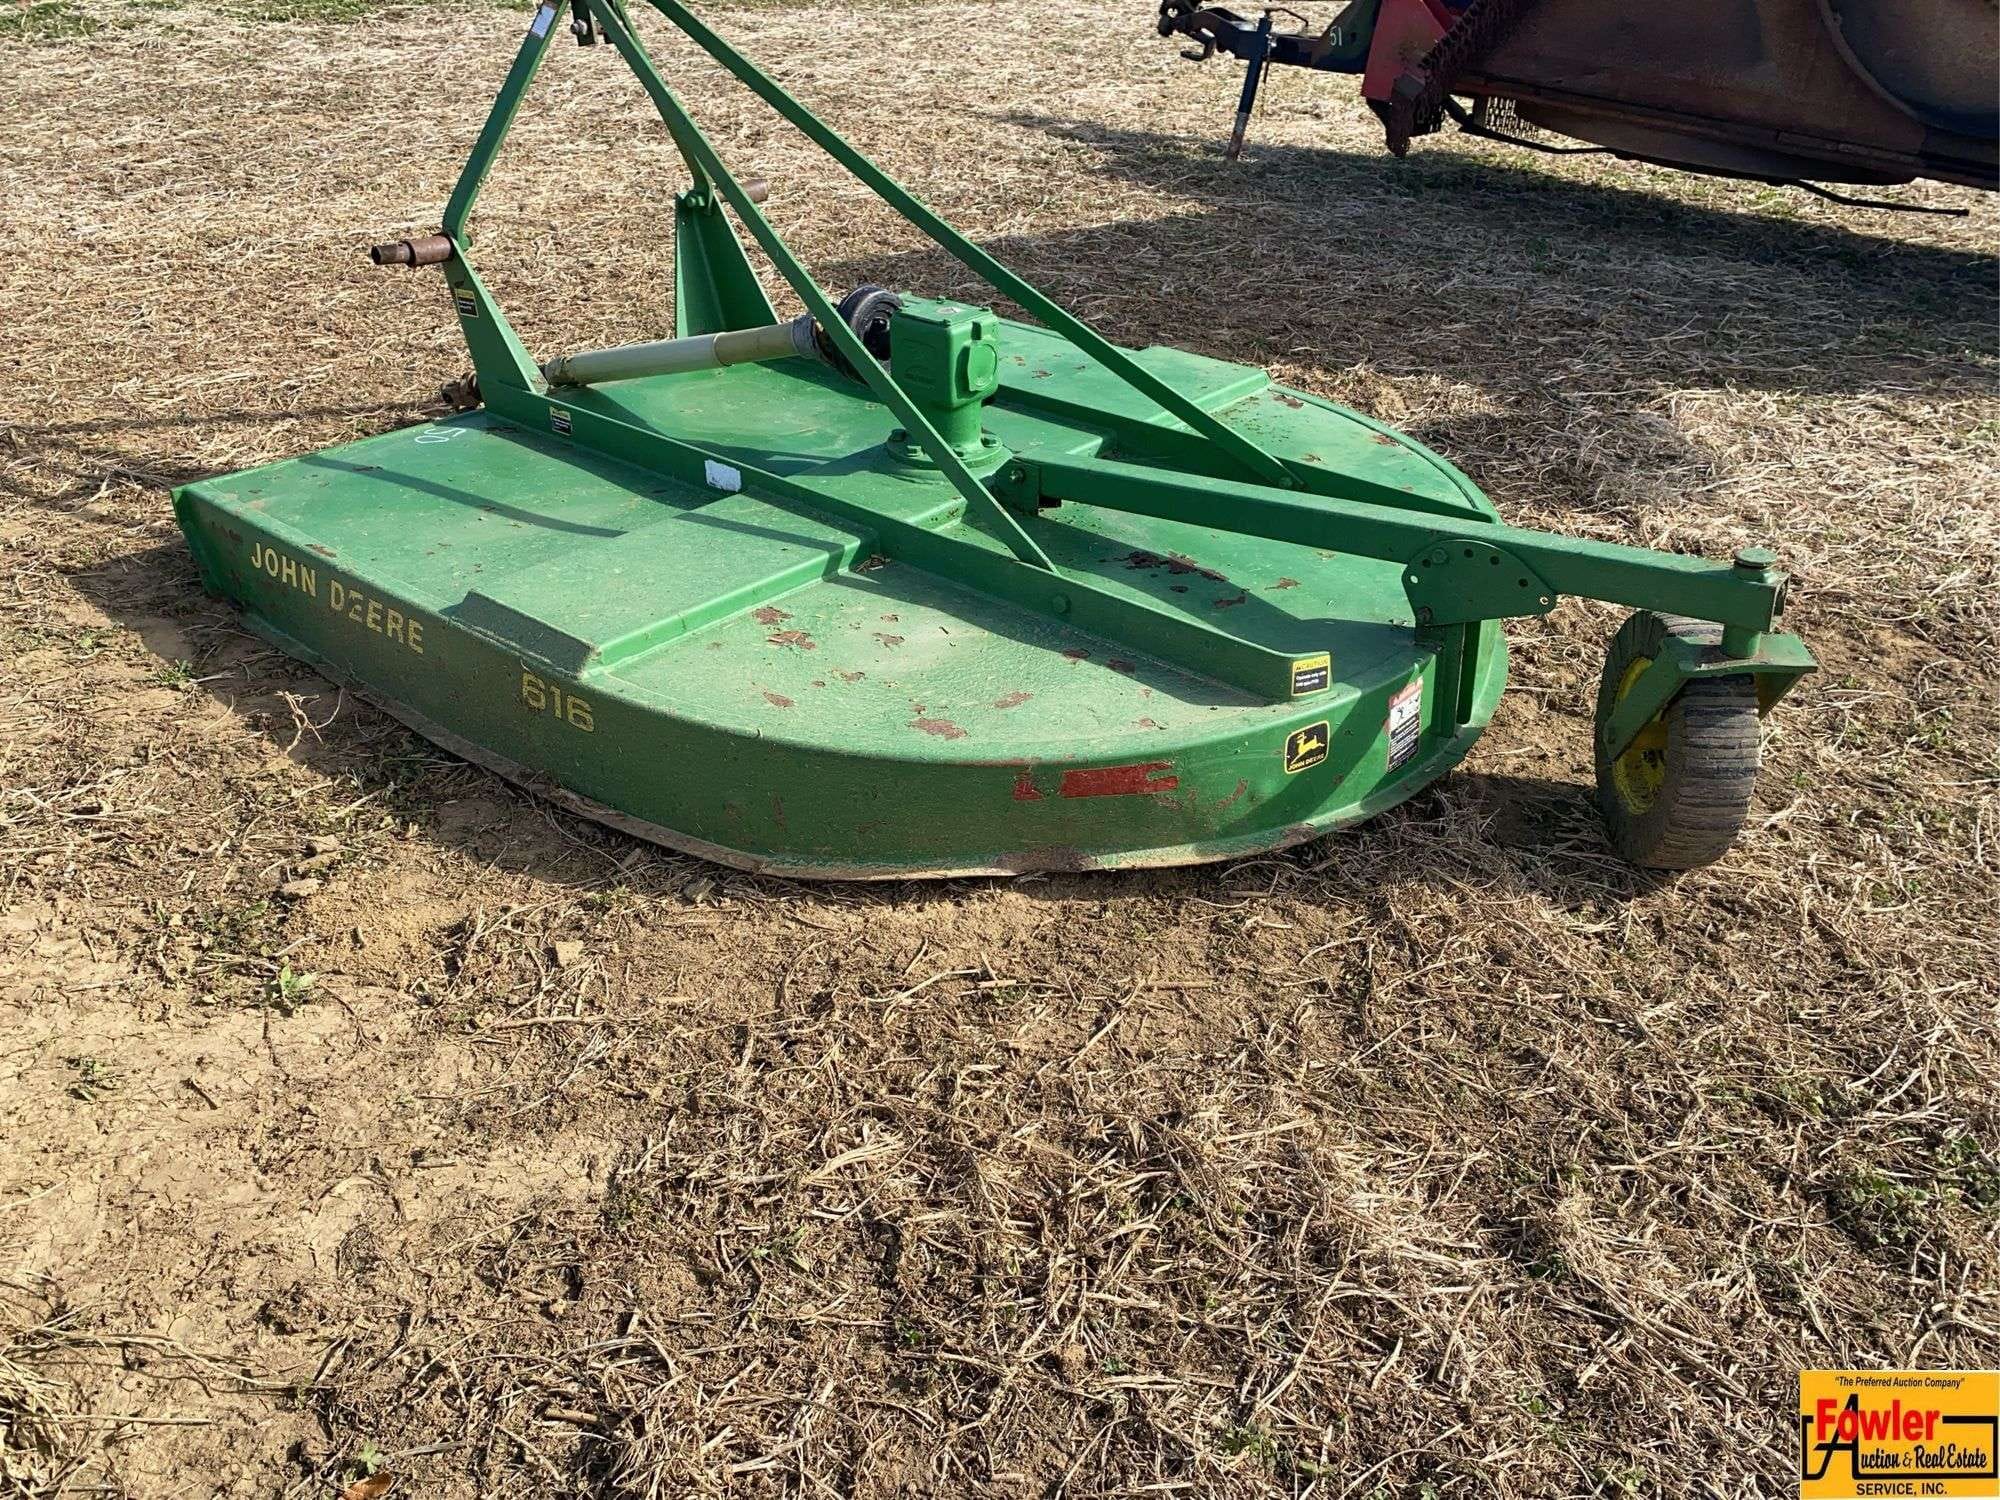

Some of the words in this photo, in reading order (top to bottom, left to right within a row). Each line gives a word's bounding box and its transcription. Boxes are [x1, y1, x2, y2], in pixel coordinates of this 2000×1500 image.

[1329, 25, 1343, 46] 51
[250, 542, 318, 597] JOHN
[329, 579, 425, 655] DEERE
[520, 671, 596, 733] 616
